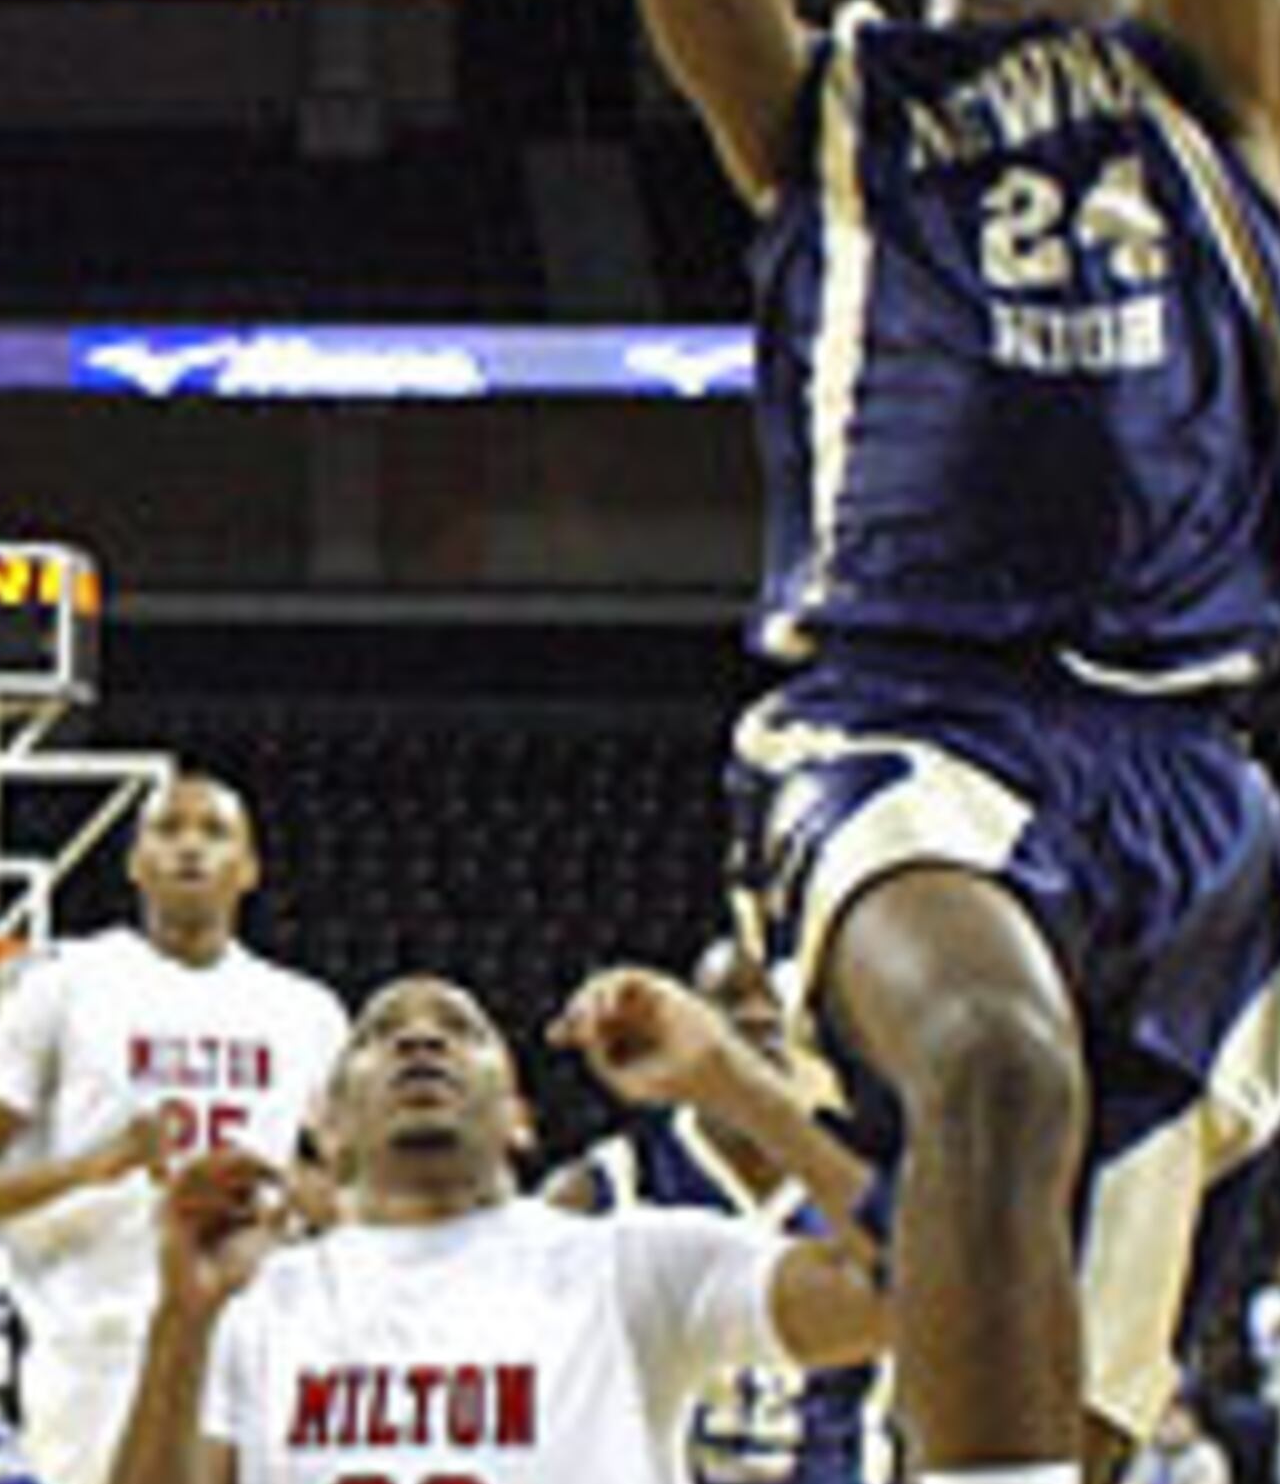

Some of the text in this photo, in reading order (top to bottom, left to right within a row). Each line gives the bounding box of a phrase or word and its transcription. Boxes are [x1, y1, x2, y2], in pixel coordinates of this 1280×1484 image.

[980, 155, 1170, 293] 24
[128, 1035, 272, 1092] MILTON
[286, 1361, 538, 1447] MILTON
